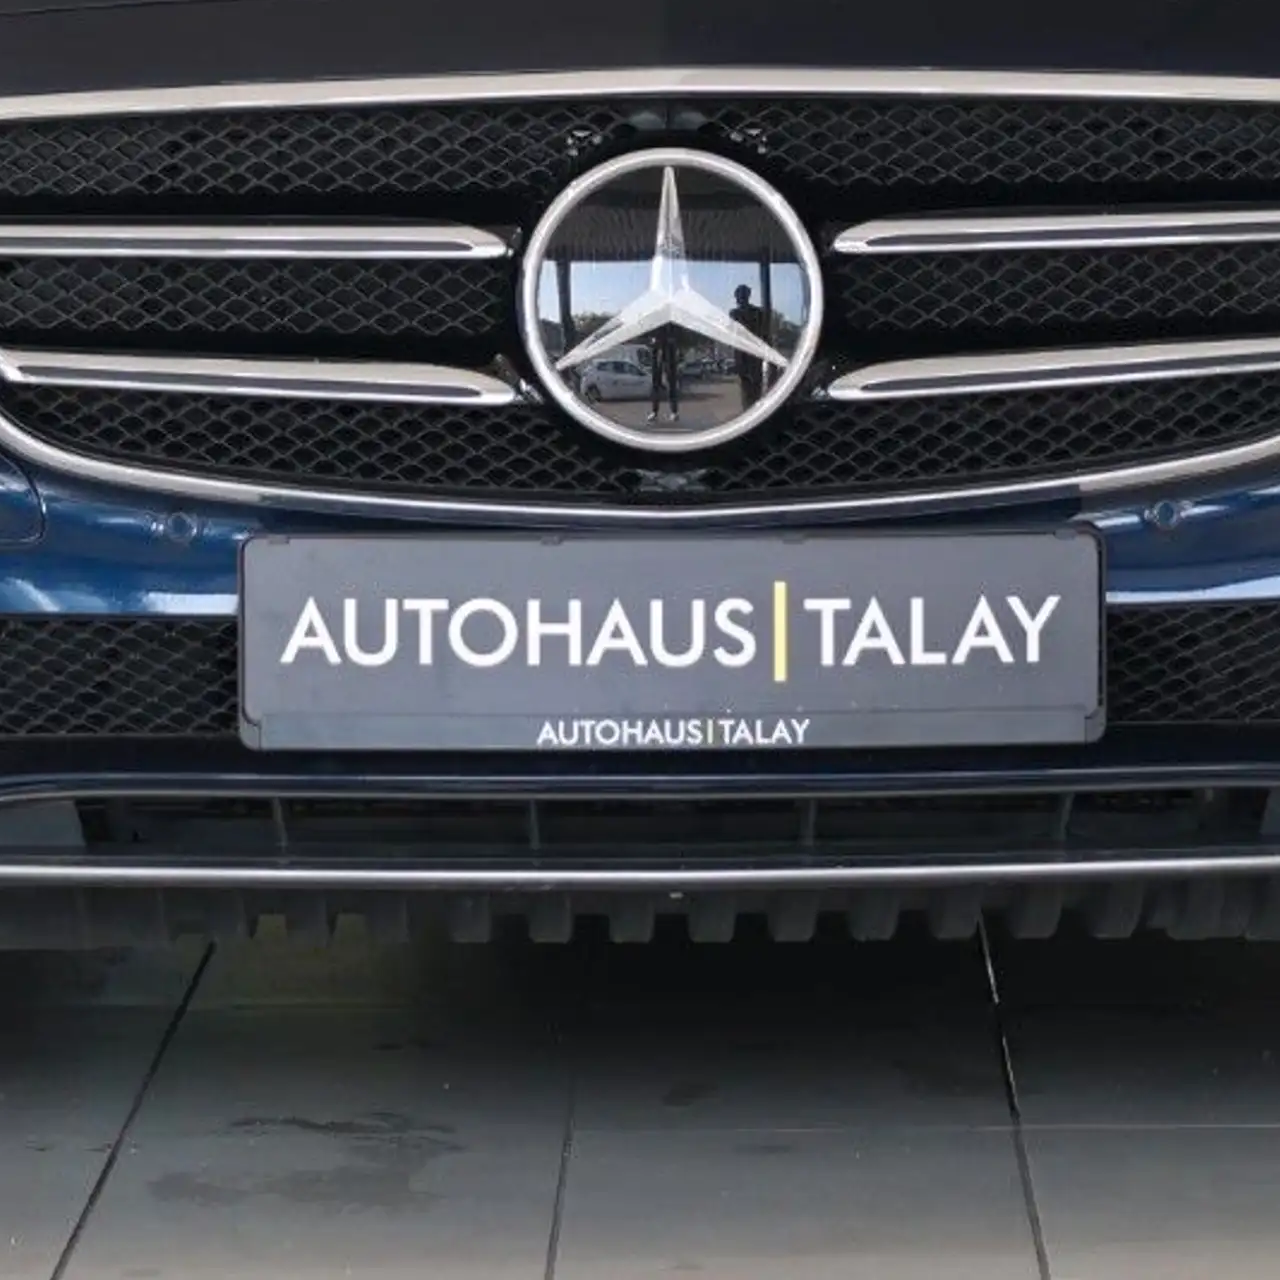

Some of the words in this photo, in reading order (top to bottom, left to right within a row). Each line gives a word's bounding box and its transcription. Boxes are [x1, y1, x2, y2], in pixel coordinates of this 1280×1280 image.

[279, 595, 756, 668] AUTOHAUS
[803, 594, 1061, 667] TALAY
[536, 718, 703, 747] AUTOHAUS
[717, 718, 811, 746] TALAY
